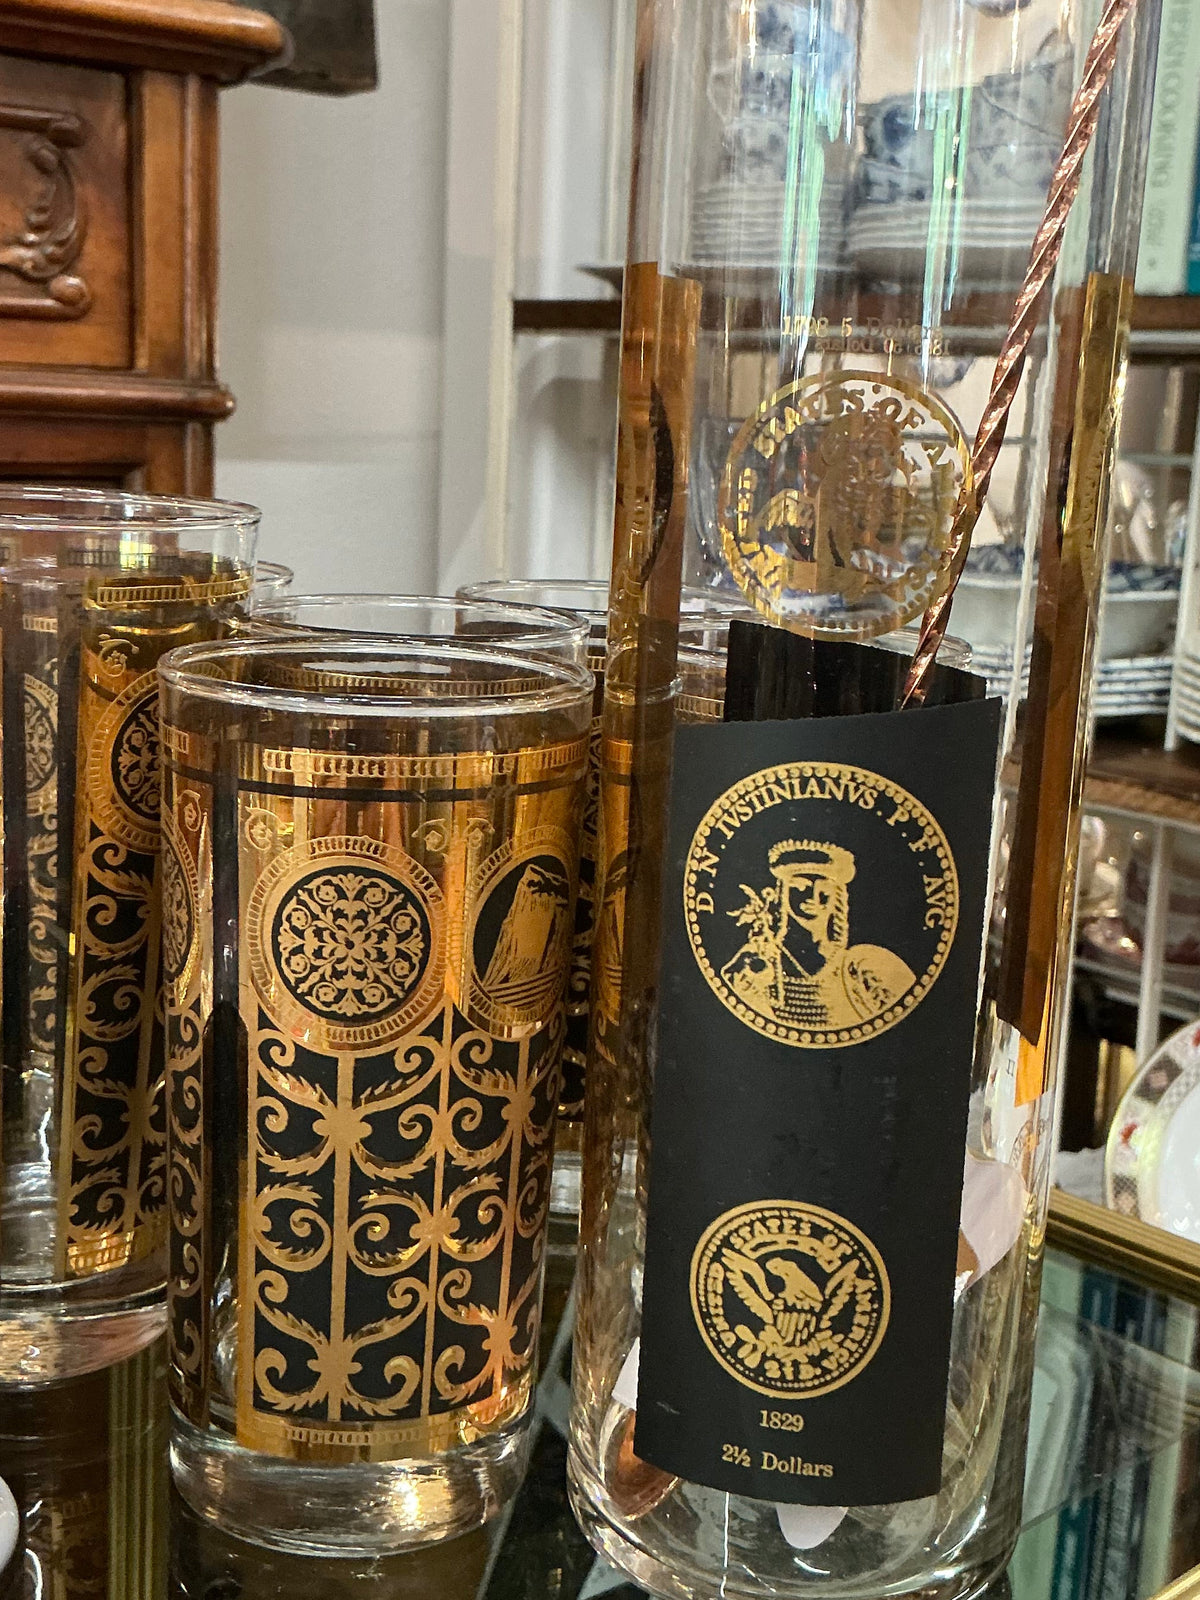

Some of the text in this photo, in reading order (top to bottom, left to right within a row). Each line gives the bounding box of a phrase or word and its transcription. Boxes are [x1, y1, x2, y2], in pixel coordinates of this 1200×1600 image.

[841, 317, 853, 338] 5
[729, 1217, 812, 1250] STATES
[823, 1233, 853, 1262] OF
[759, 1409, 804, 1433] 1829
[760, 1450, 834, 1478] Dollars
